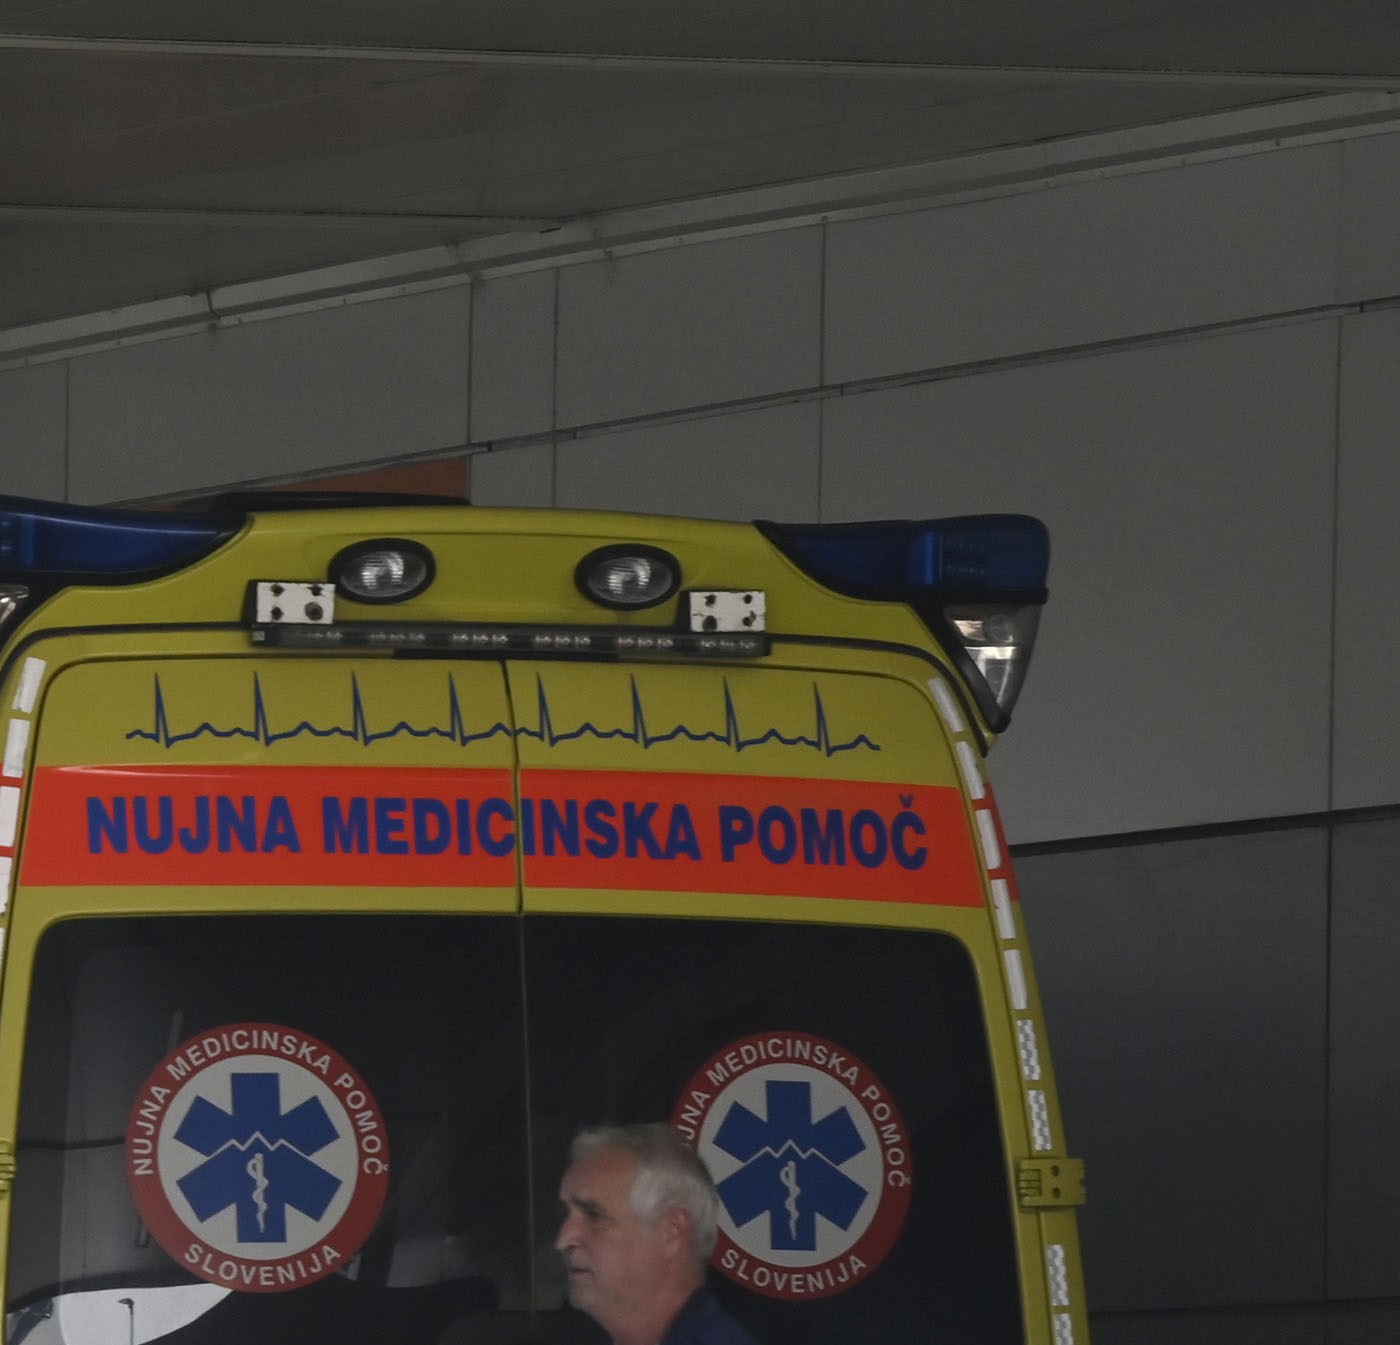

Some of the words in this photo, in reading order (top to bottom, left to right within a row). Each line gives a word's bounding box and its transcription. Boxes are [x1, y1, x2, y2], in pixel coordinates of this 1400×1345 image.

[86, 795, 302, 855] NUJNA
[321, 796, 703, 861] MEDICINSKA
[718, 794, 929, 871] POMOČ
[132, 1084, 171, 1175] NUJNA
[166, 1030, 331, 1081] MEDICINSKA
[334, 1073, 389, 1175] POMOČ
[676, 1090, 711, 1145] JNA
[706, 1038, 860, 1087] MEDICINSKA
[861, 1085, 911, 1187] POMOČ
[184, 1243, 341, 1286] SLOVENIJA
[720, 1249, 867, 1293] SLOVENIJA
